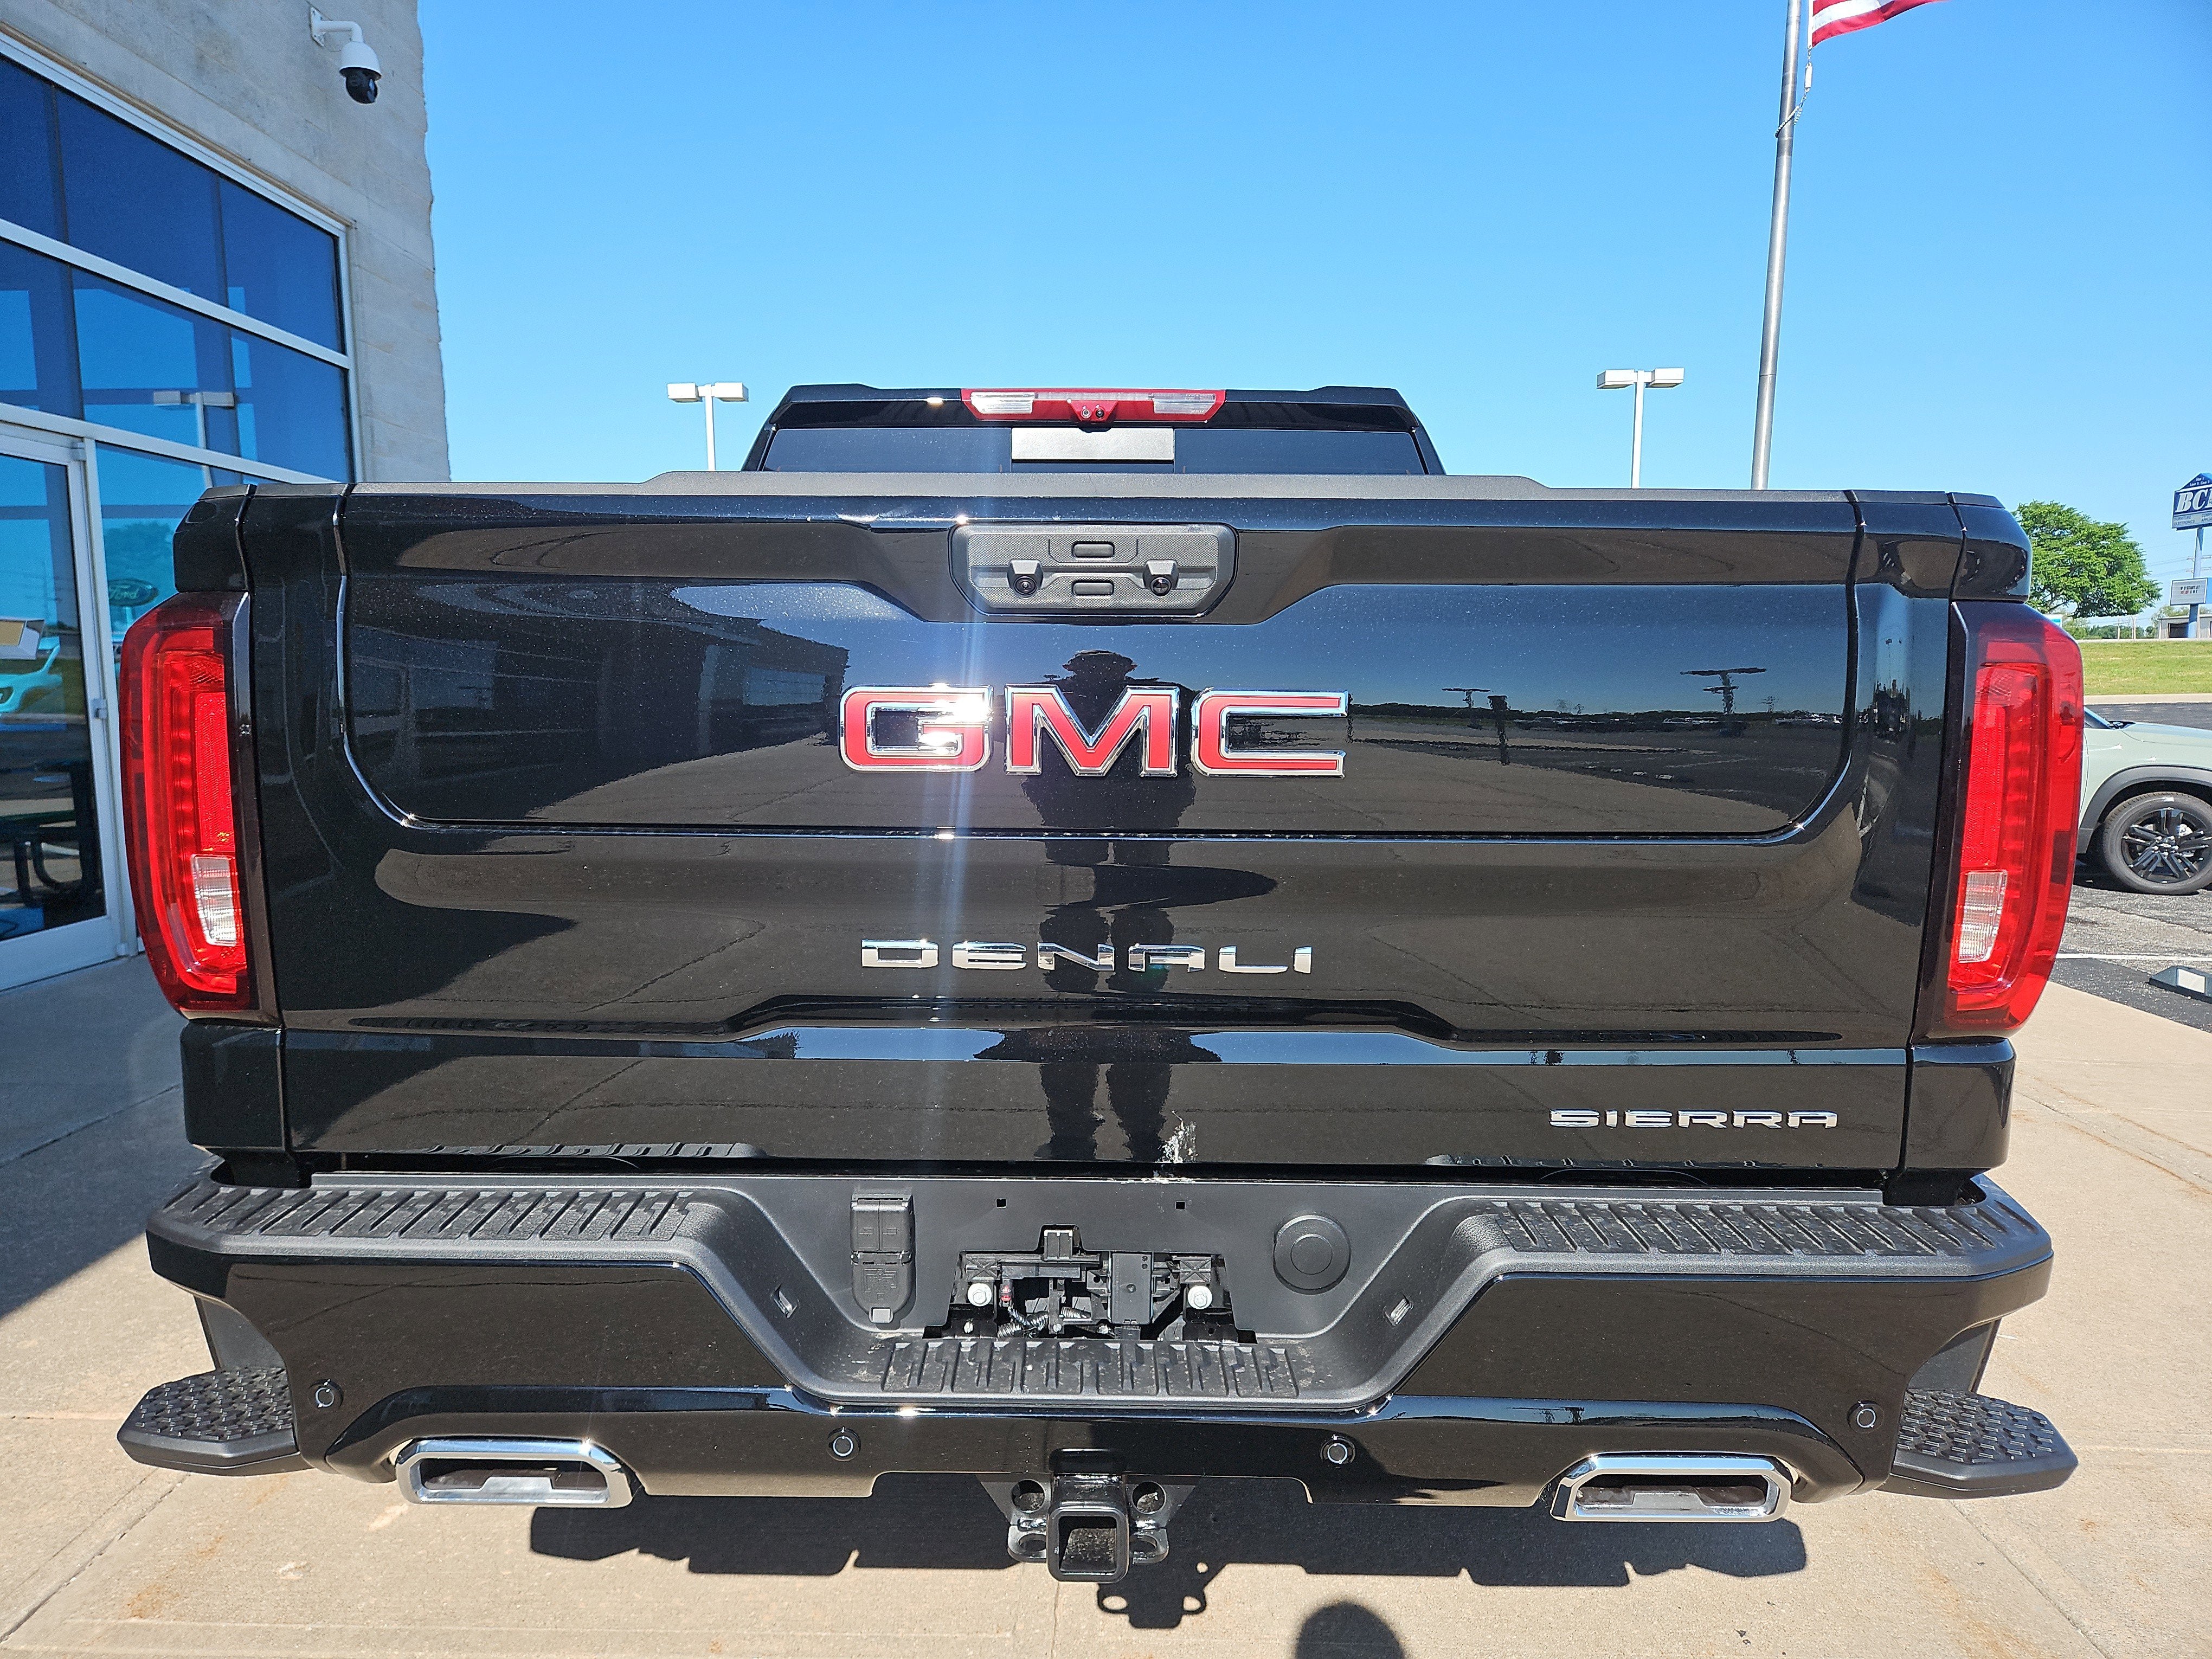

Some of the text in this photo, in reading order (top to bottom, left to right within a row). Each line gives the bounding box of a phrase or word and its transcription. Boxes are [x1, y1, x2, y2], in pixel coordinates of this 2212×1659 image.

[839, 684, 1349, 779] GMC
[861, 938, 1313, 974] DENALI
[1549, 1109, 1838, 1129] SIERRA
